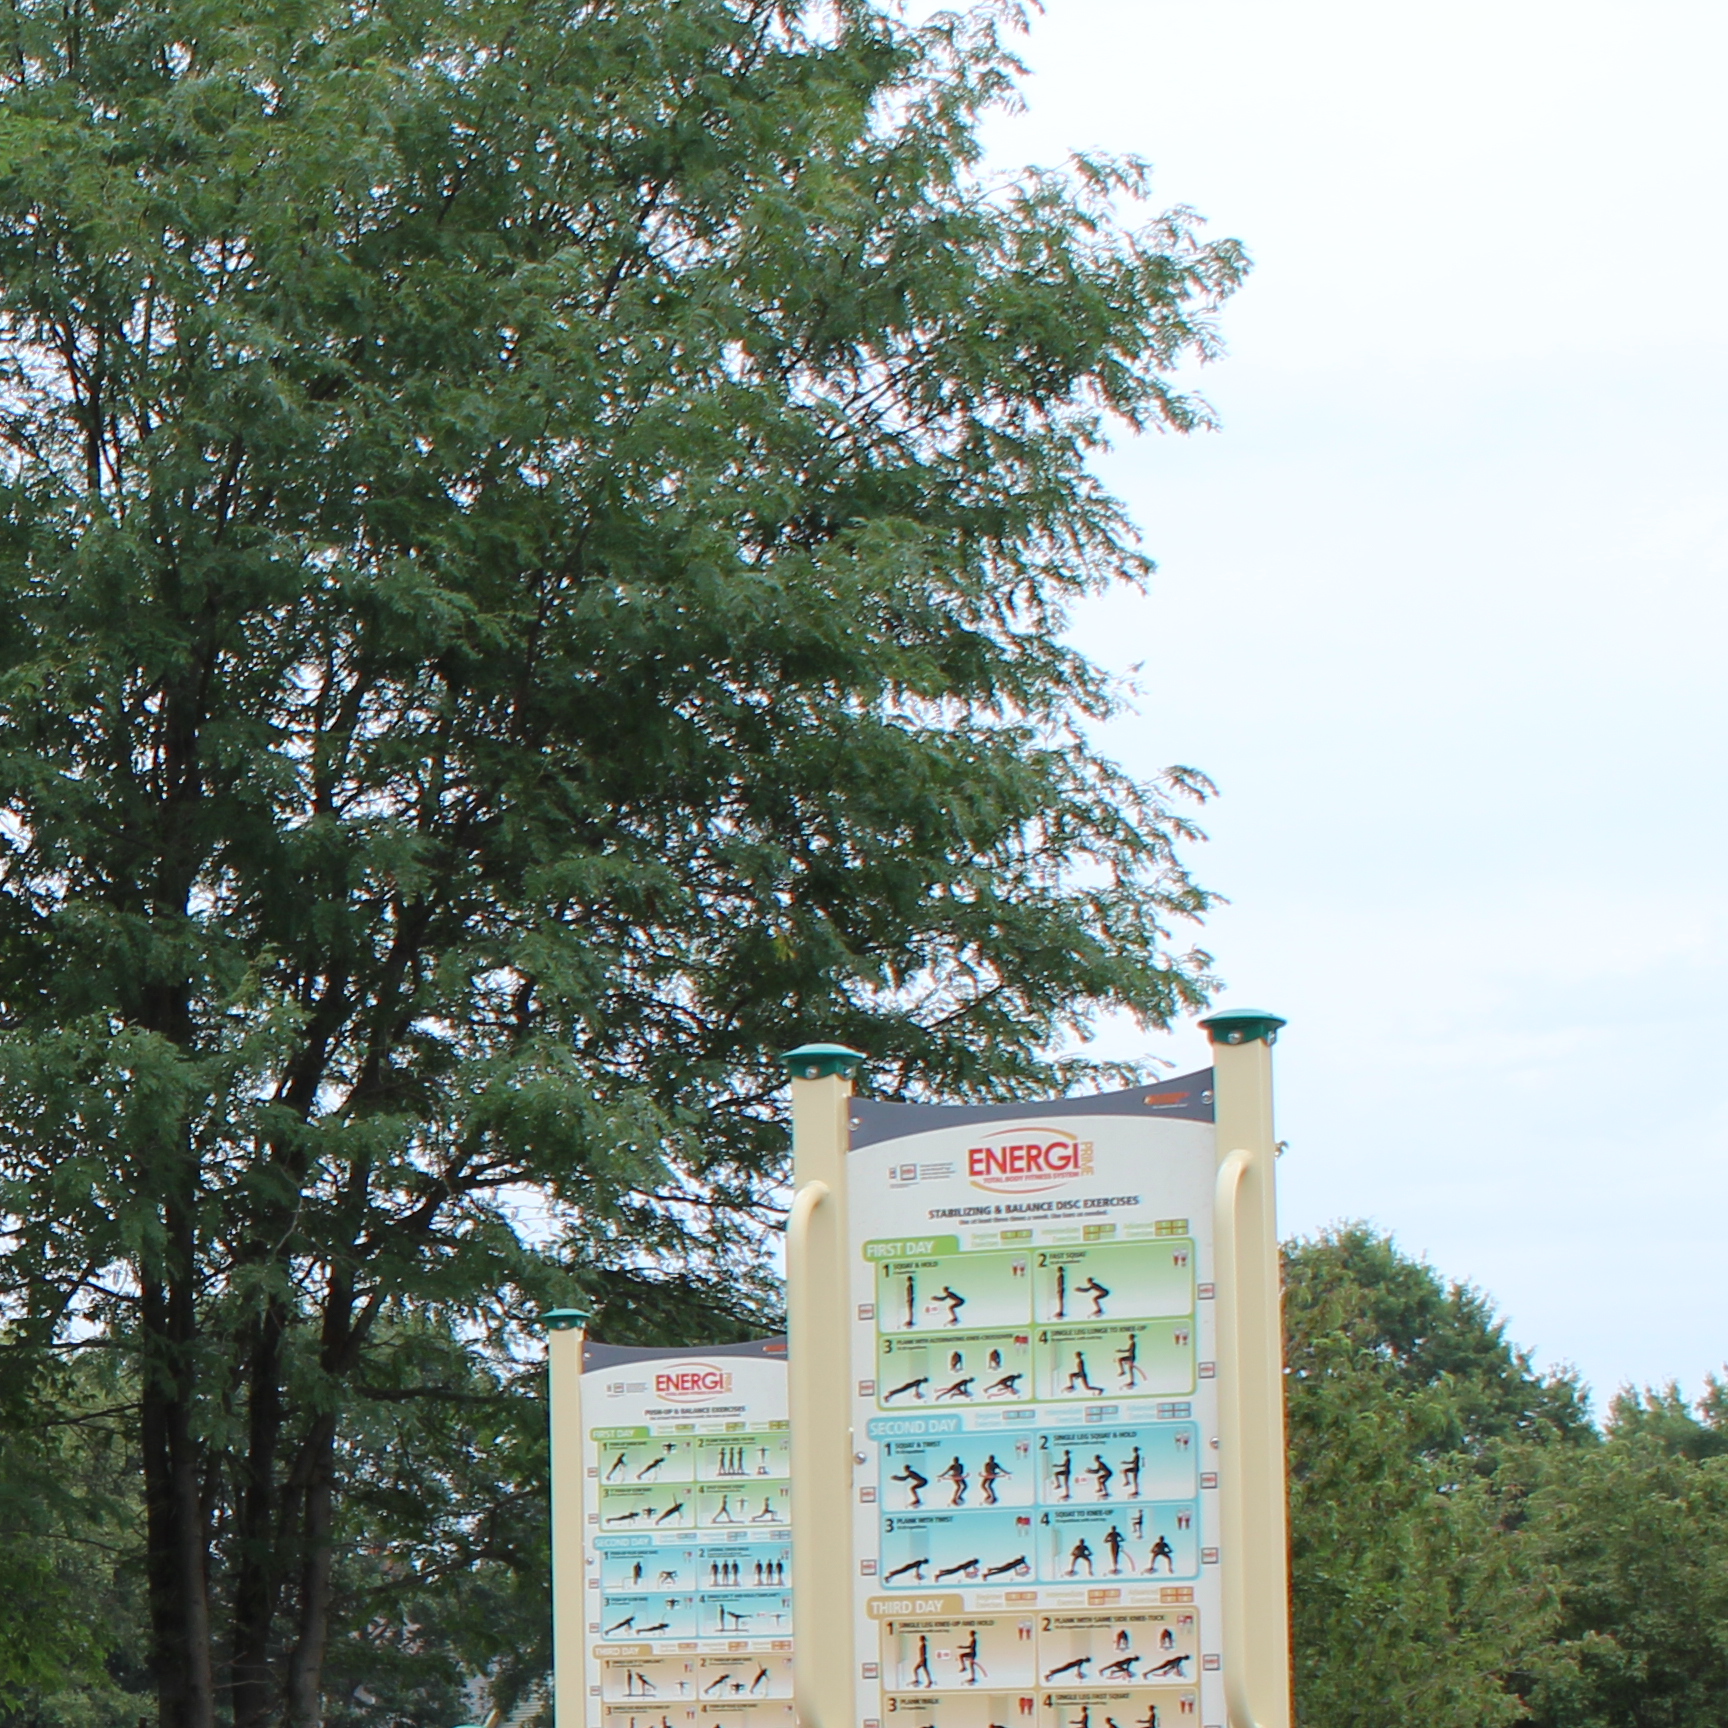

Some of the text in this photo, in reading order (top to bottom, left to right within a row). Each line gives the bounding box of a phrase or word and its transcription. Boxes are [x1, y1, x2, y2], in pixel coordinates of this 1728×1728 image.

[968, 1141, 1080, 1177] ENERGI
[1081, 1141, 1094, 1176] PRIME
[928, 1195, 1139, 1219] STABILIZING & BALANCE DISC EXERCISES
[866, 1241, 934, 1258] FIRST DAY
[655, 1372, 724, 1392] ENERGI
[869, 1419, 958, 1436] SECOND DAY
[871, 1599, 944, 1615] THIRD DAY
